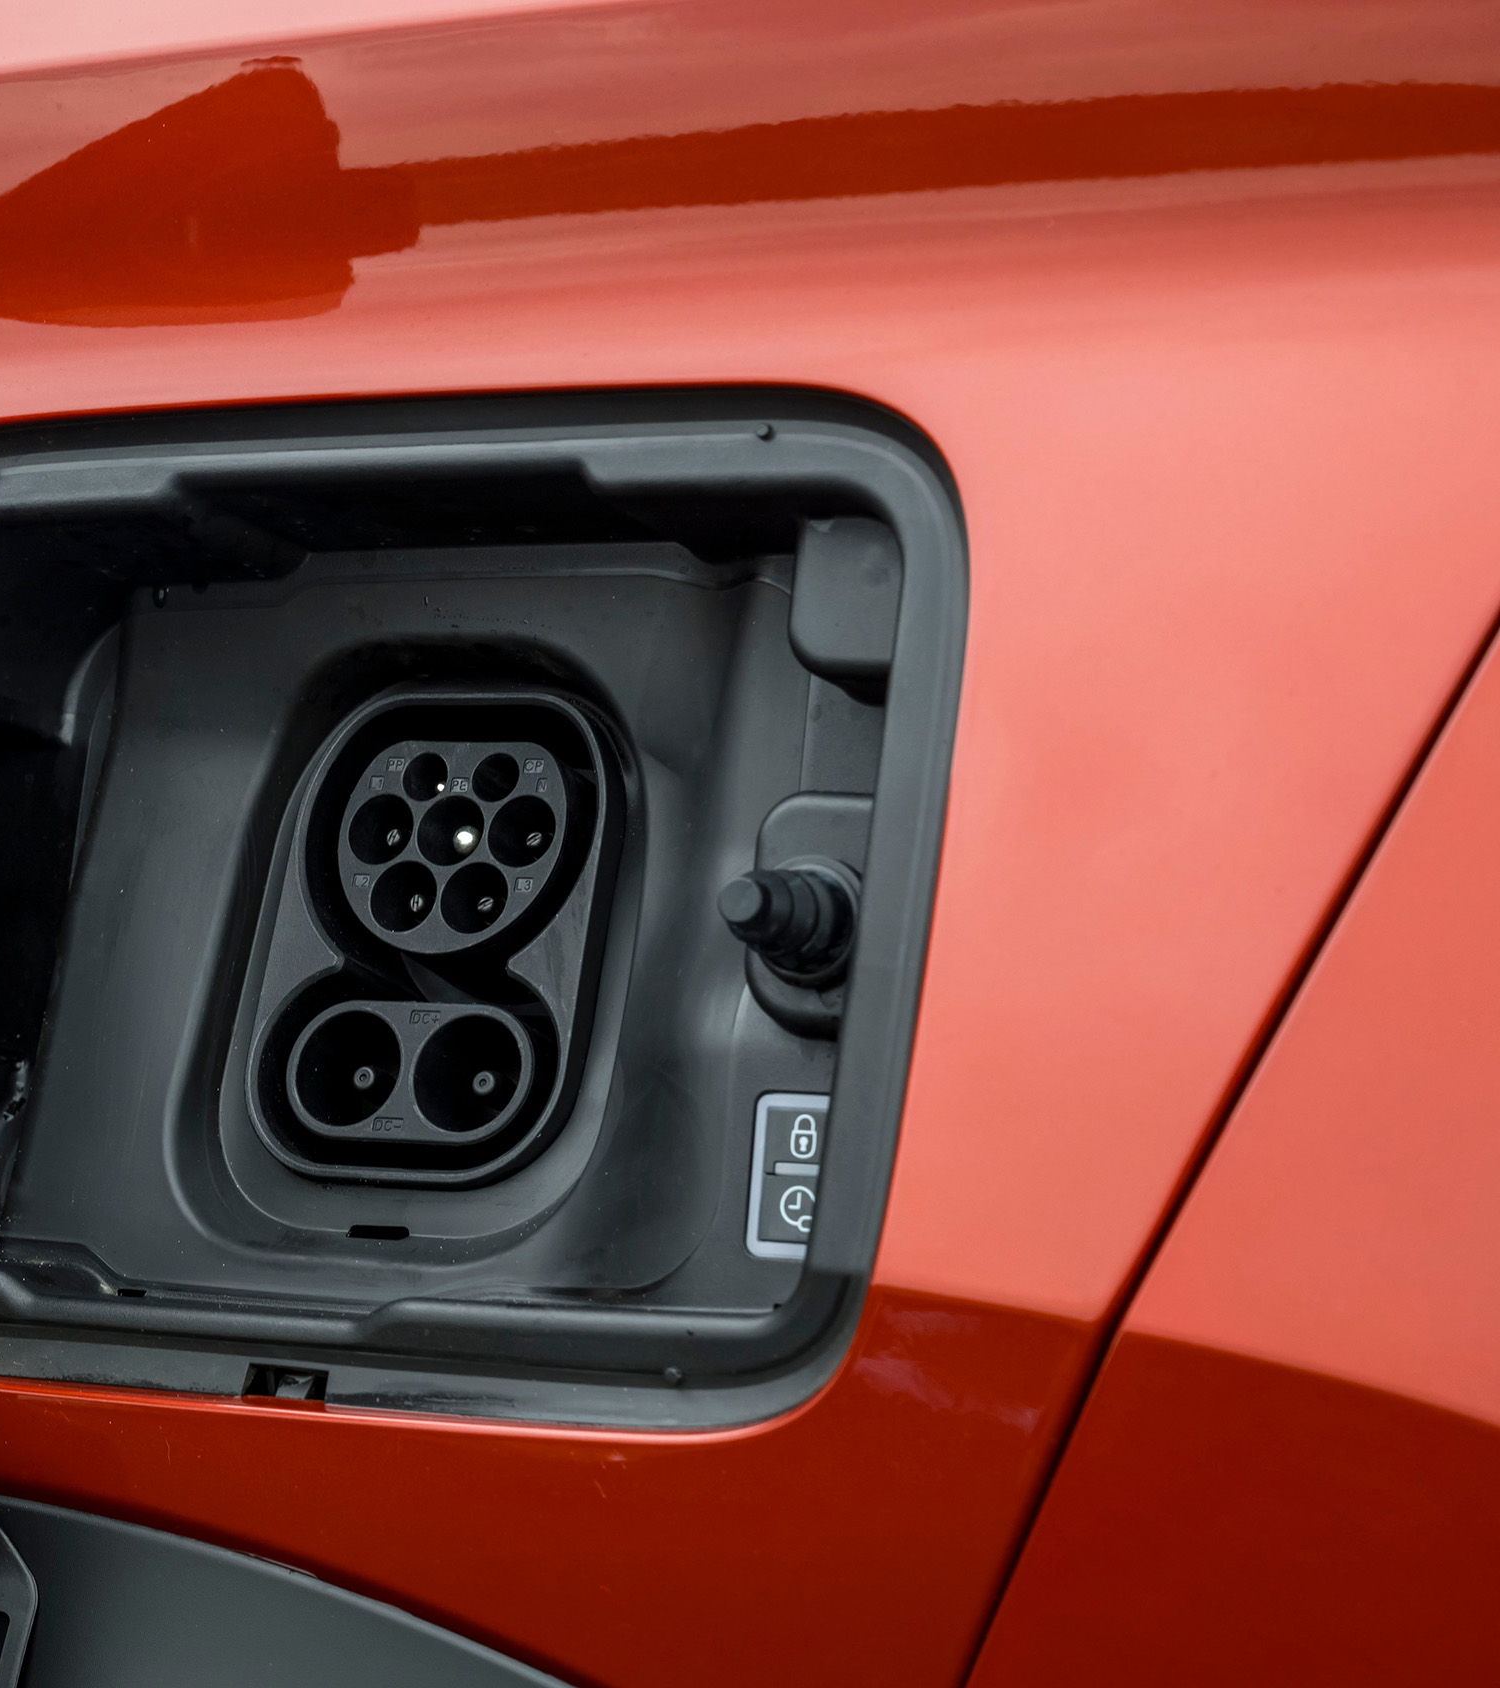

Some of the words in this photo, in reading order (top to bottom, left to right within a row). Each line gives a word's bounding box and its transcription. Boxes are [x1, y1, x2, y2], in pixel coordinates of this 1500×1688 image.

[388, 760, 404, 770] PP
[524, 760, 543, 772] CP
[452, 780, 467, 791] PE
[354, 876, 369, 888] L2
[516, 880, 531, 891] L3
